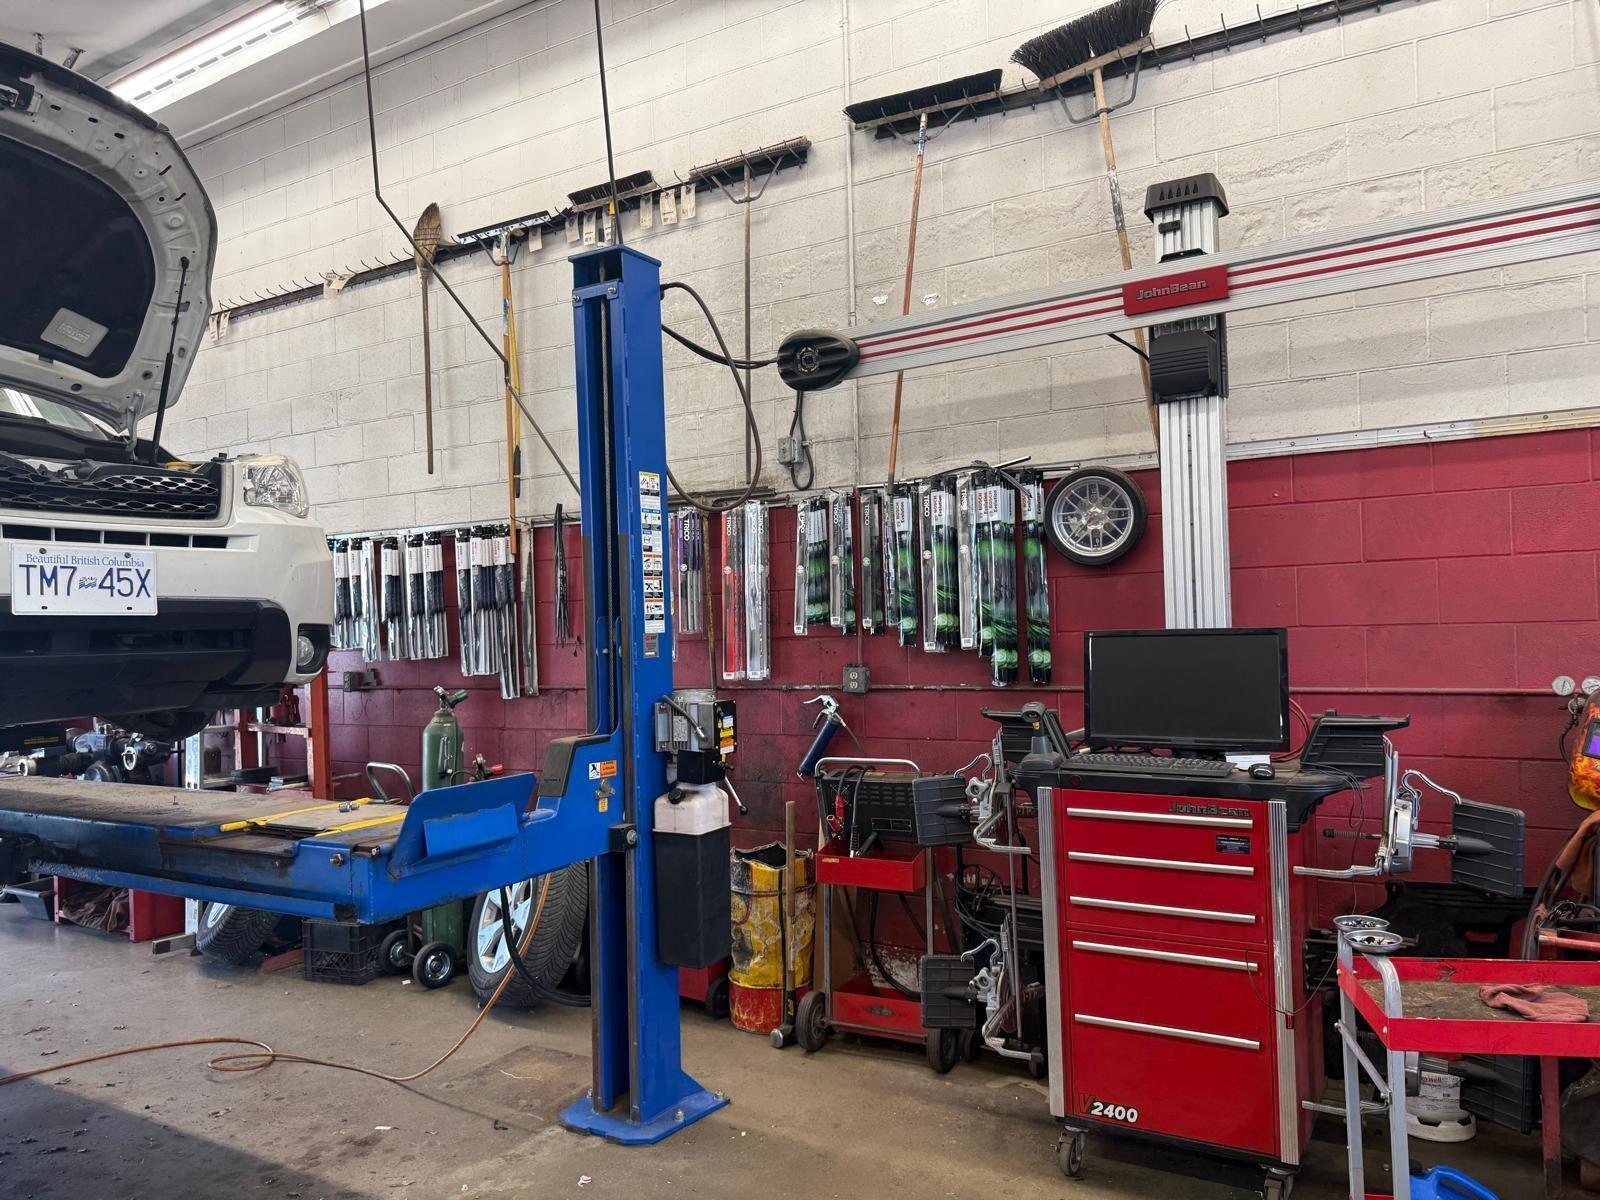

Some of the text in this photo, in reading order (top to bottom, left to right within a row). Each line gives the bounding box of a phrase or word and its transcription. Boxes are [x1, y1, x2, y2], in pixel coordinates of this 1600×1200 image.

[1136, 280, 1208, 301] JohnBean
[26, 553, 145, 568] Beautiful British Columbia
[18, 564, 152, 598] TM7 45X
[1168, 802, 1251, 817] JohnBean
